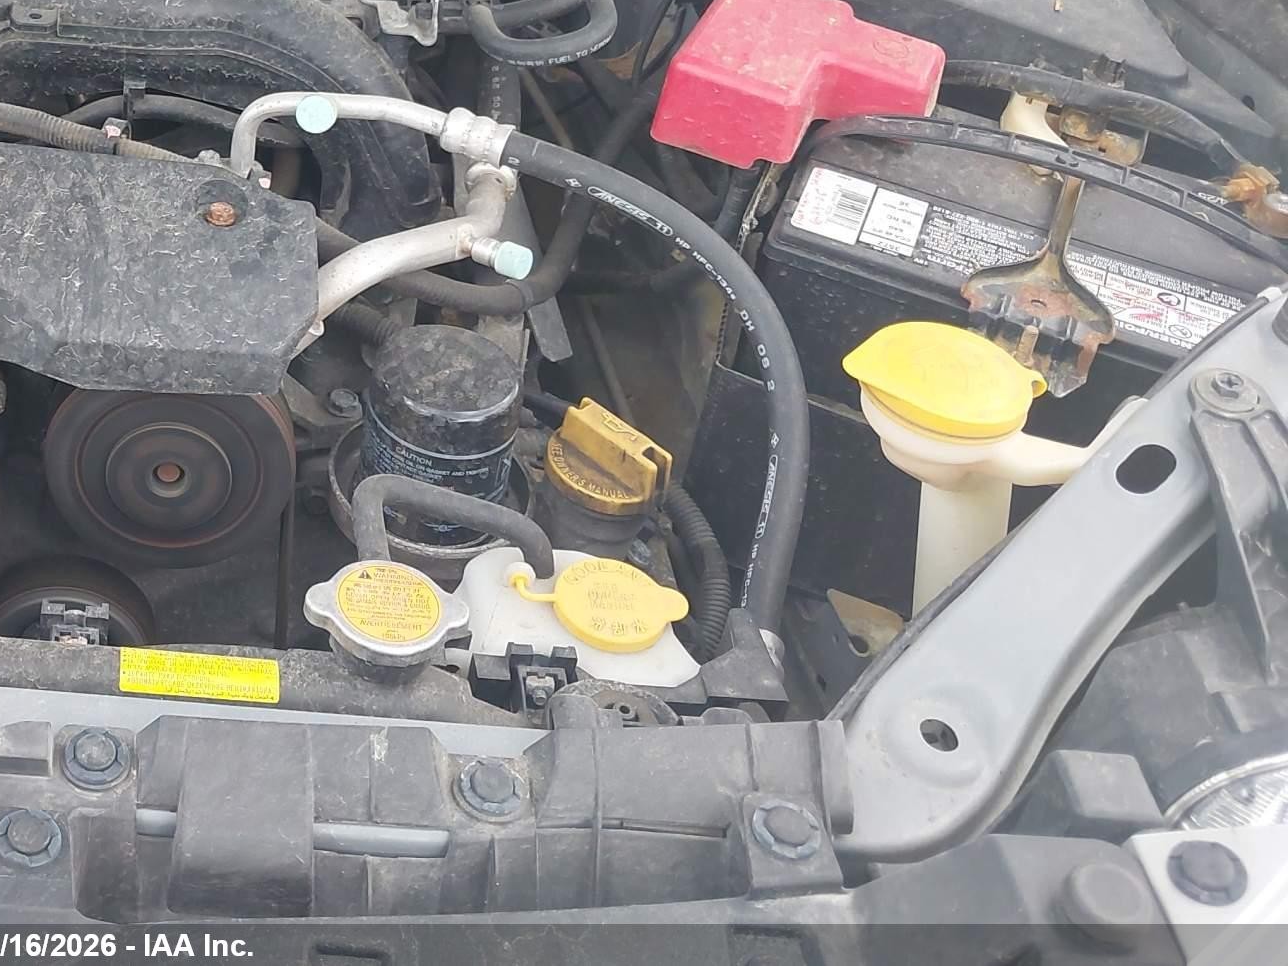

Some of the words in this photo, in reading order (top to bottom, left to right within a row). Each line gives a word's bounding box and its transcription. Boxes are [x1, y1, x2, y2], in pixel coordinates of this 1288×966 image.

[548, 55, 572, 65] FUEL
[395, 446, 432, 466] CAUTION
[588, 482, 629, 499] MANUAL
